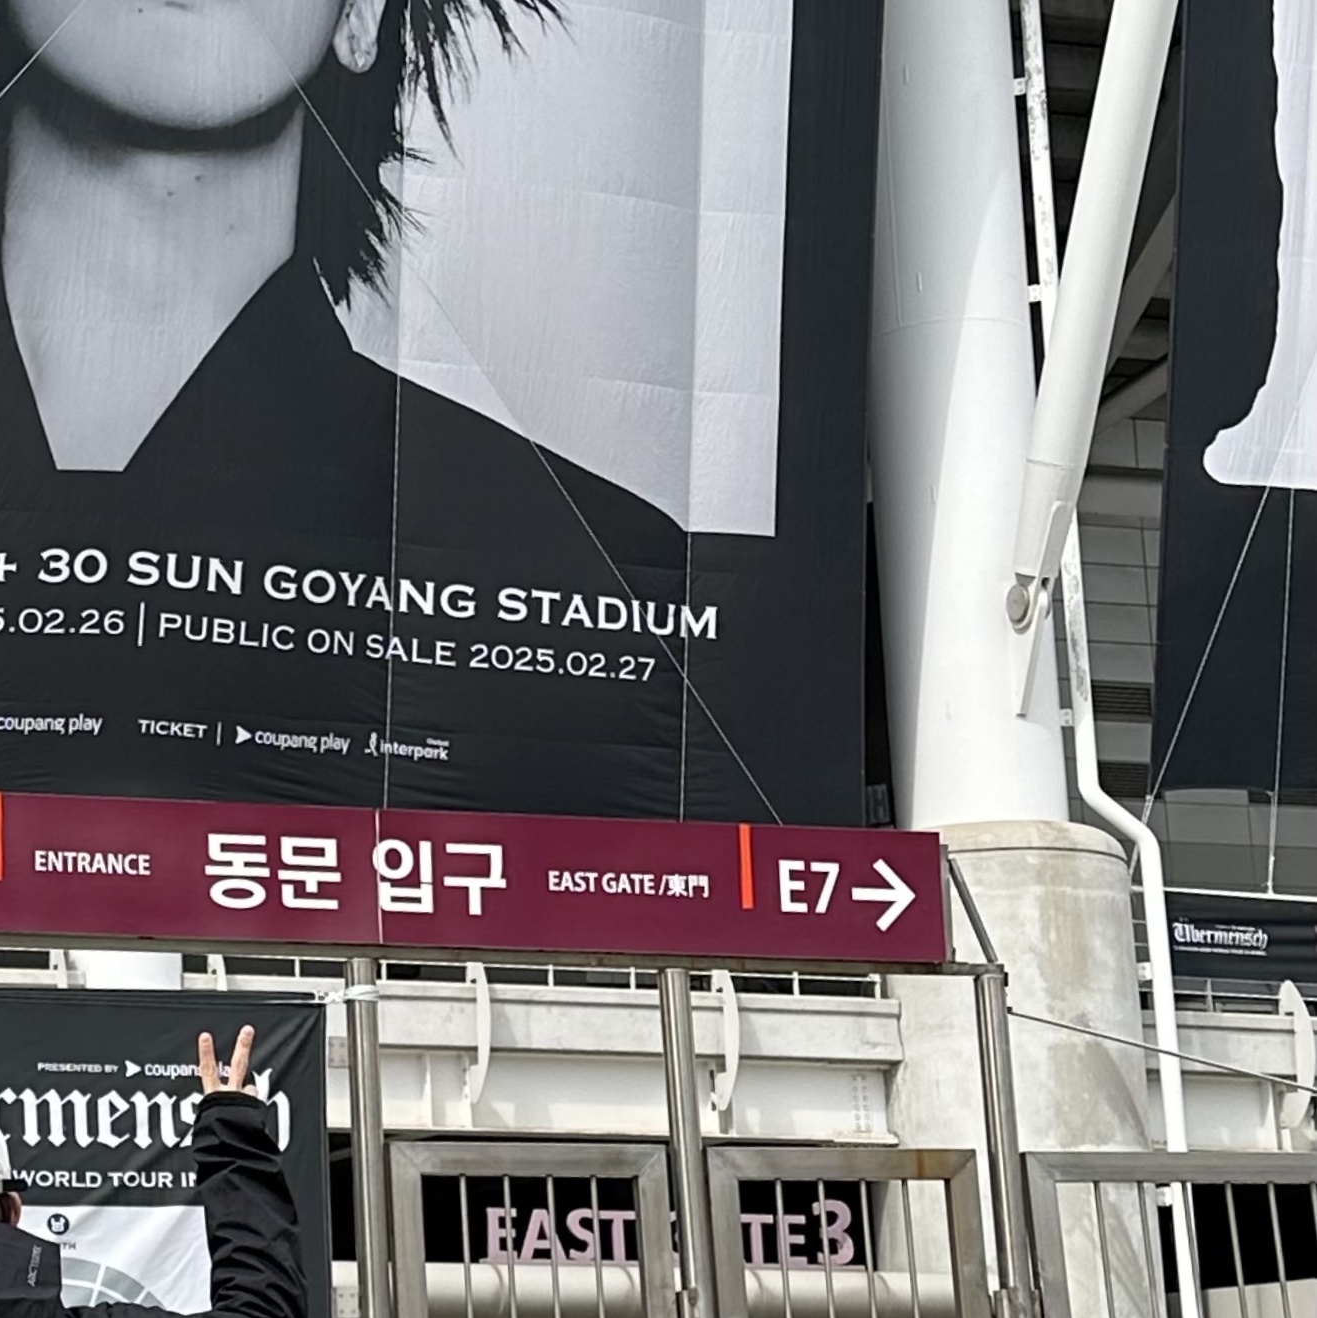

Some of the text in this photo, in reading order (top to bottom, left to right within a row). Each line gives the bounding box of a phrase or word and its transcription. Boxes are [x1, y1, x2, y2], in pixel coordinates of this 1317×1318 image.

[38, 548, 108, 584] 30
[127, 550, 244, 595] SUN
[263, 564, 476, 619] GOYANG
[497, 587, 718, 641] STADIUM
[158, 613, 295, 651] PUBLIC
[306, 627, 355, 656] ON
[365, 633, 456, 668] SALE
[469, 643, 656, 682] 2025.02.27
[68, 713, 103, 735] play
[138, 719, 208, 738] TICKET
[255, 730, 351, 755] coupang play
[380, 739, 449, 761] interpark
[33, 849, 151, 879] ENTRANCE
[204, 832, 508, 916] 동문 입구
[548, 870, 598, 892] EAST
[601, 872, 656, 895] GATE
[778, 855, 840, 917] E7
[37, 1062, 102, 1073] PRESENTED
[104, 1064, 119, 1073] BY
[144, 1063, 201, 1080] coupan
[14, 1170, 102, 1189] WORLD
[108, 1171, 173, 1189] TOUR
[485, 1206, 637, 1262] EAST
